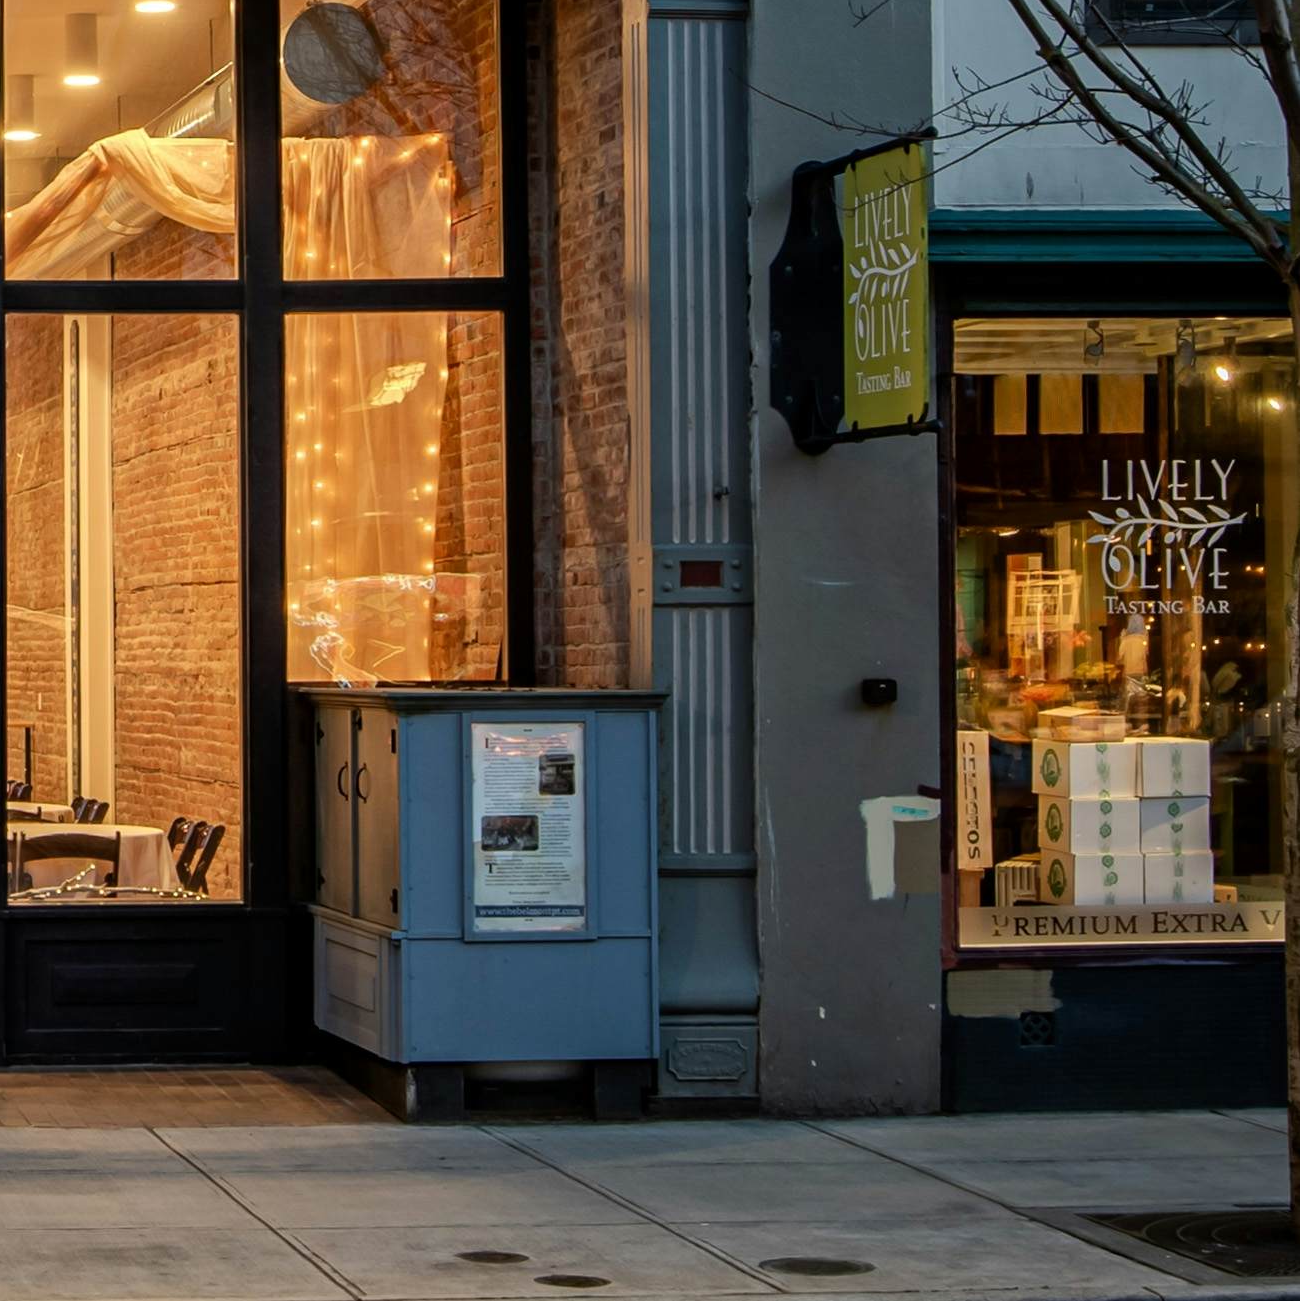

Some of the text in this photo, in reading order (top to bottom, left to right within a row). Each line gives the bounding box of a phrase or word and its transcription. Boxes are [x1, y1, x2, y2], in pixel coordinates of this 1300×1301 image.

[854, 184, 912, 248] LIVELY
[855, 299, 911, 361] OLIVE
[893, 366, 911, 390] BAR
[1102, 459, 1236, 500] LIVELY
[1101, 544, 1230, 590] OLIVE
[1103, 595, 1231, 614] TASTING BAR
[992, 914, 1138, 937] PREMIUM
[1150, 910, 1249, 934] EXTRA
